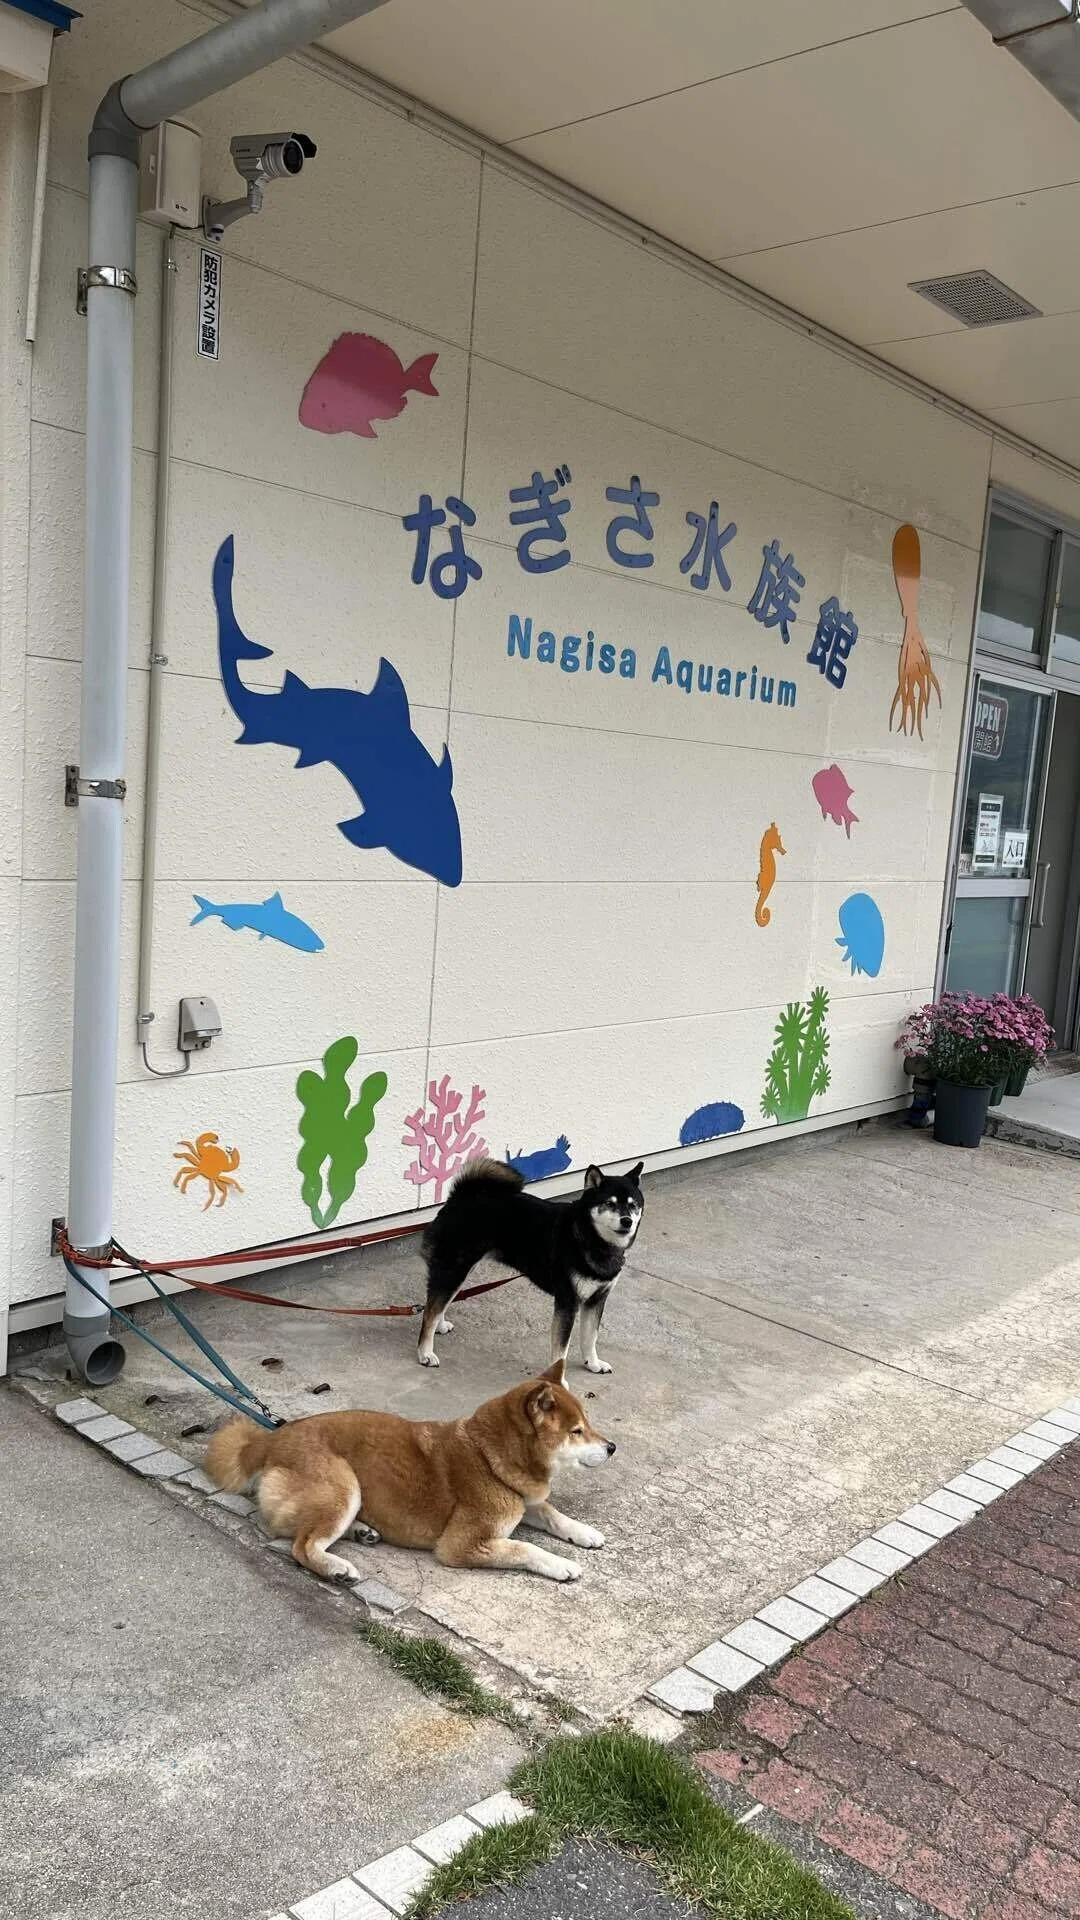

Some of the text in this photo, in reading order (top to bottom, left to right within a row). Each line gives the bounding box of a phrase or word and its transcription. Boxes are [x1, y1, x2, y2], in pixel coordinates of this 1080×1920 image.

[201, 254, 219, 355] 防犯カメラ設置
[402, 464, 859, 690] なぎさ水族館
[507, 614, 797, 708] Nagisa Aquarium
[1005, 839, 1025, 859] 入口
